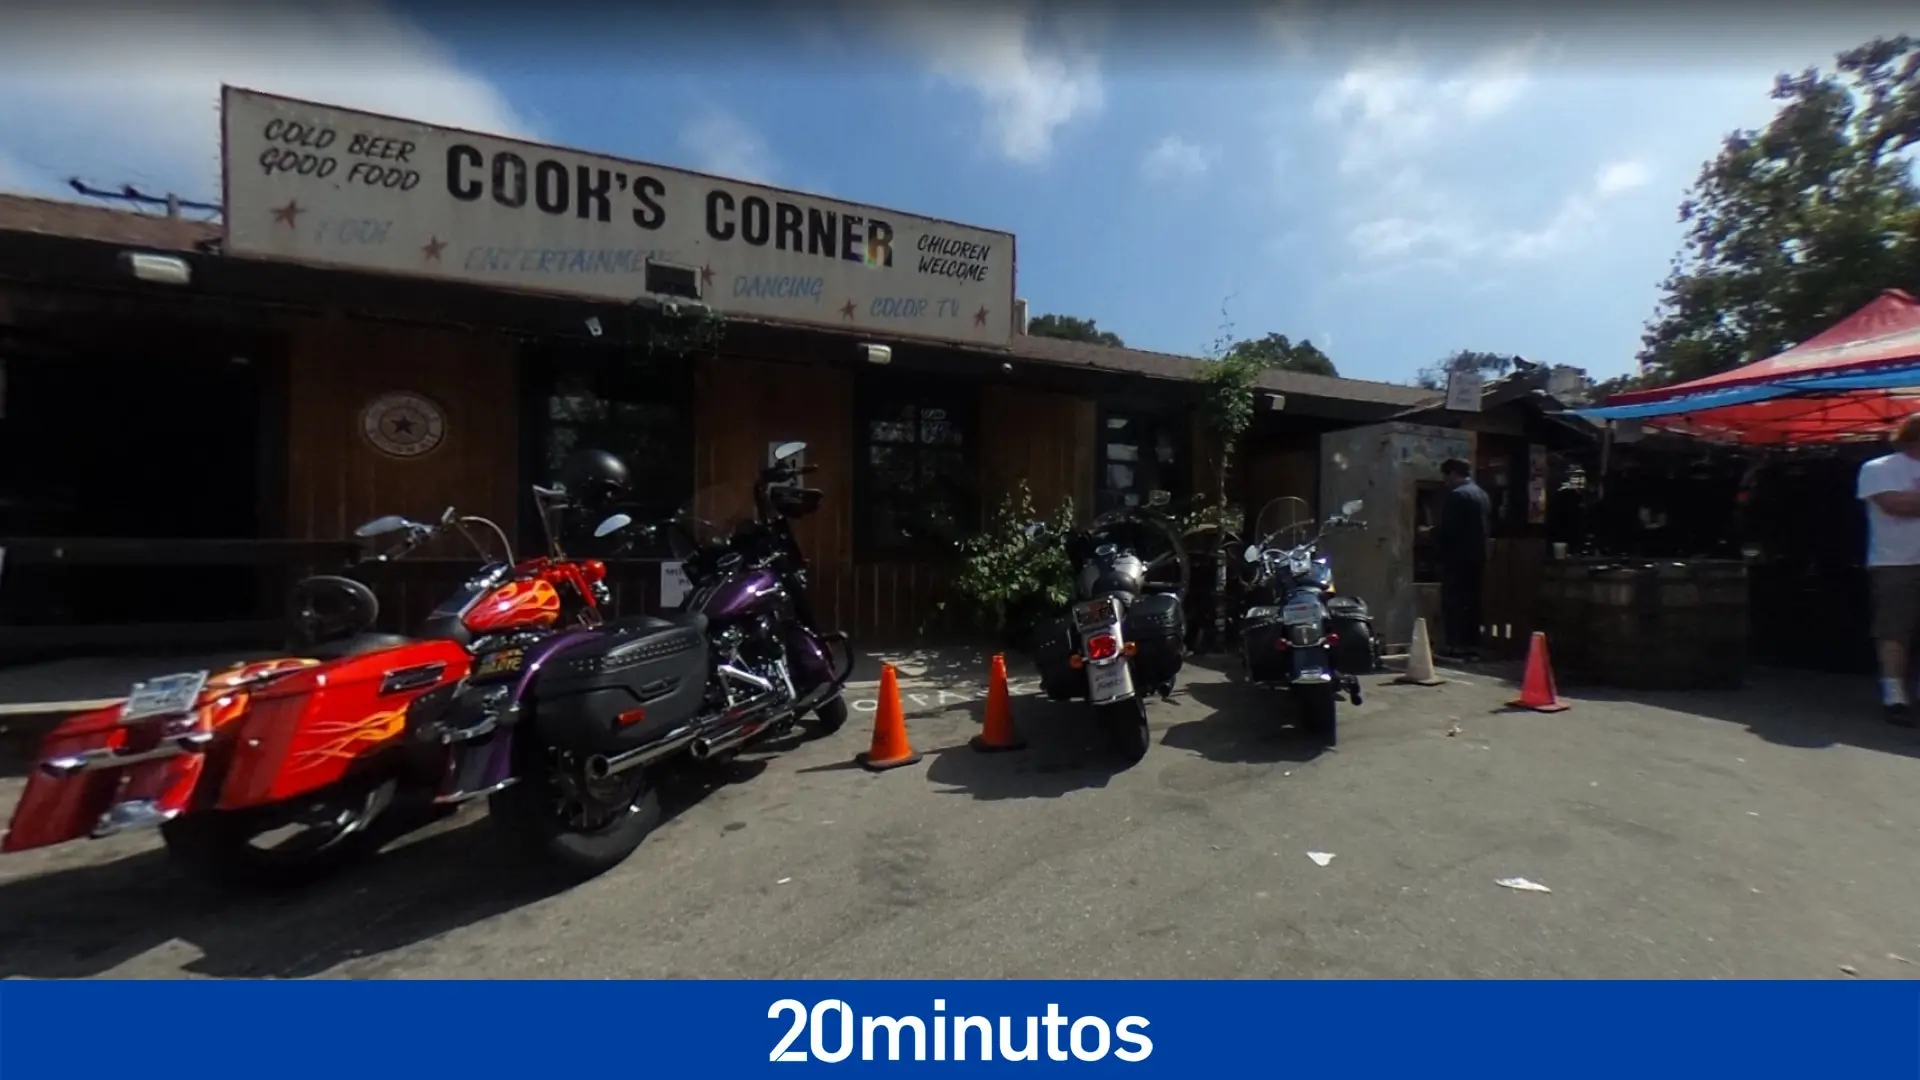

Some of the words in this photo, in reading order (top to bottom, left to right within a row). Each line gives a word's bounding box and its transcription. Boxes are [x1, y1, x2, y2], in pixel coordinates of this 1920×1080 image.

[265, 119, 336, 149] COLD
[348, 133, 416, 163] BEER
[259, 147, 337, 179] GOOD
[348, 163, 420, 191] FOOD
[447, 144, 666, 230] COOK'S
[705, 190, 894, 267] CORNER
[918, 234, 990, 261] CHILDREN
[919, 258, 988, 282] WELCOME
[733, 275, 824, 302] DANCING
[869, 297, 929, 320] COLOR
[936, 299, 960, 319] TV
